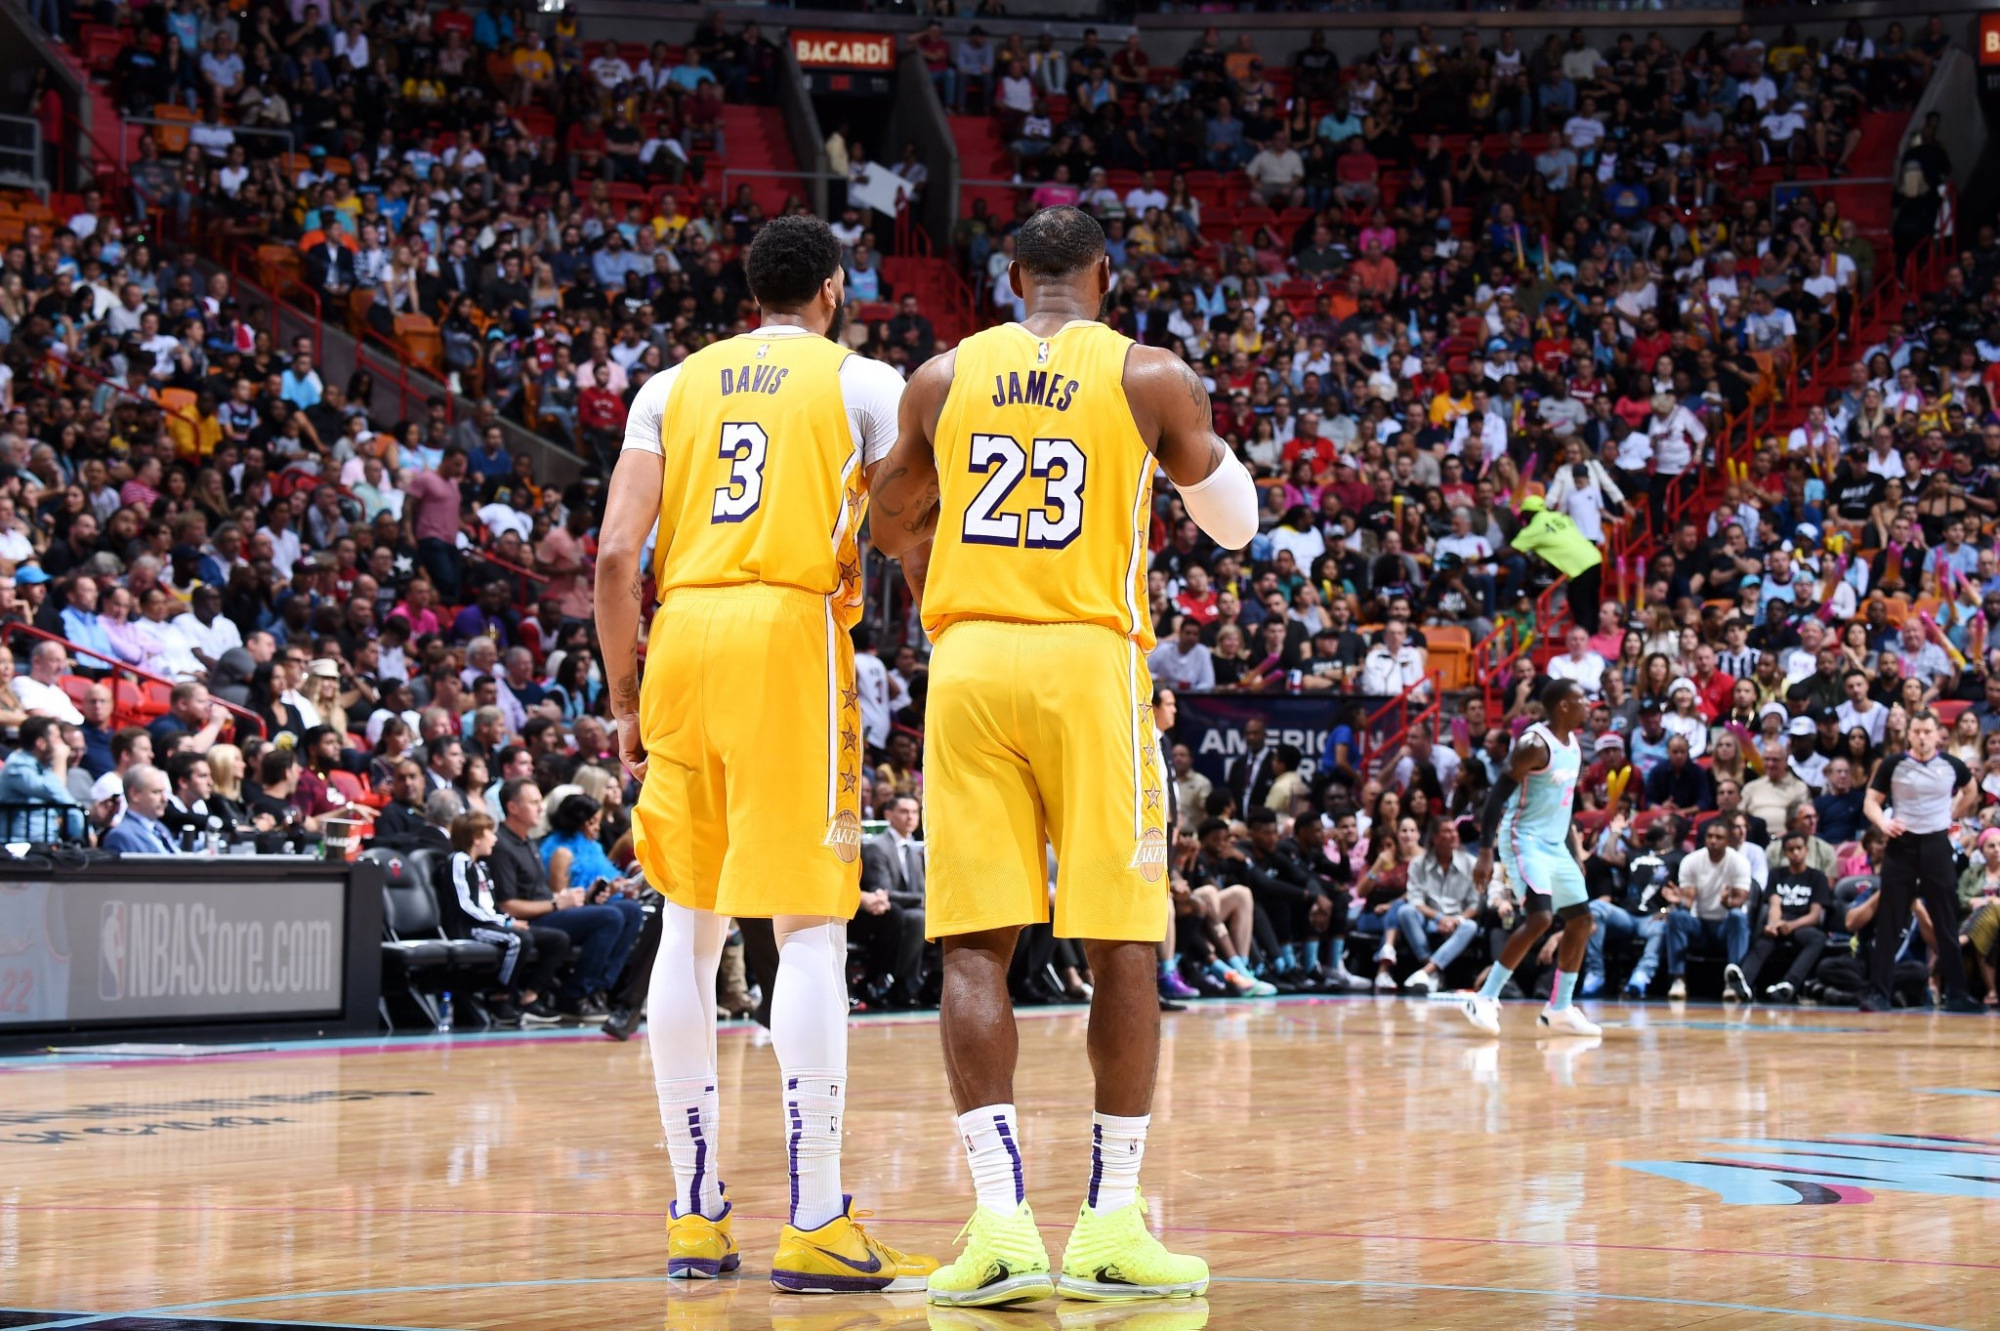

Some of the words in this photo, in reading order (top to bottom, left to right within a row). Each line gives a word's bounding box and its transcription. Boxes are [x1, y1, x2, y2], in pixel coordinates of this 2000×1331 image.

[796, 38, 890, 64] BACARDÍ
[721, 364, 789, 396] DAVIS
[992, 370, 1079, 412] JAMES
[711, 422, 769, 525] 3
[961, 433, 1087, 550] 23
[821, 820, 861, 847] LAKER
[1127, 840, 1166, 868] LAKER
[129, 902, 332, 997] NBAStore.com
